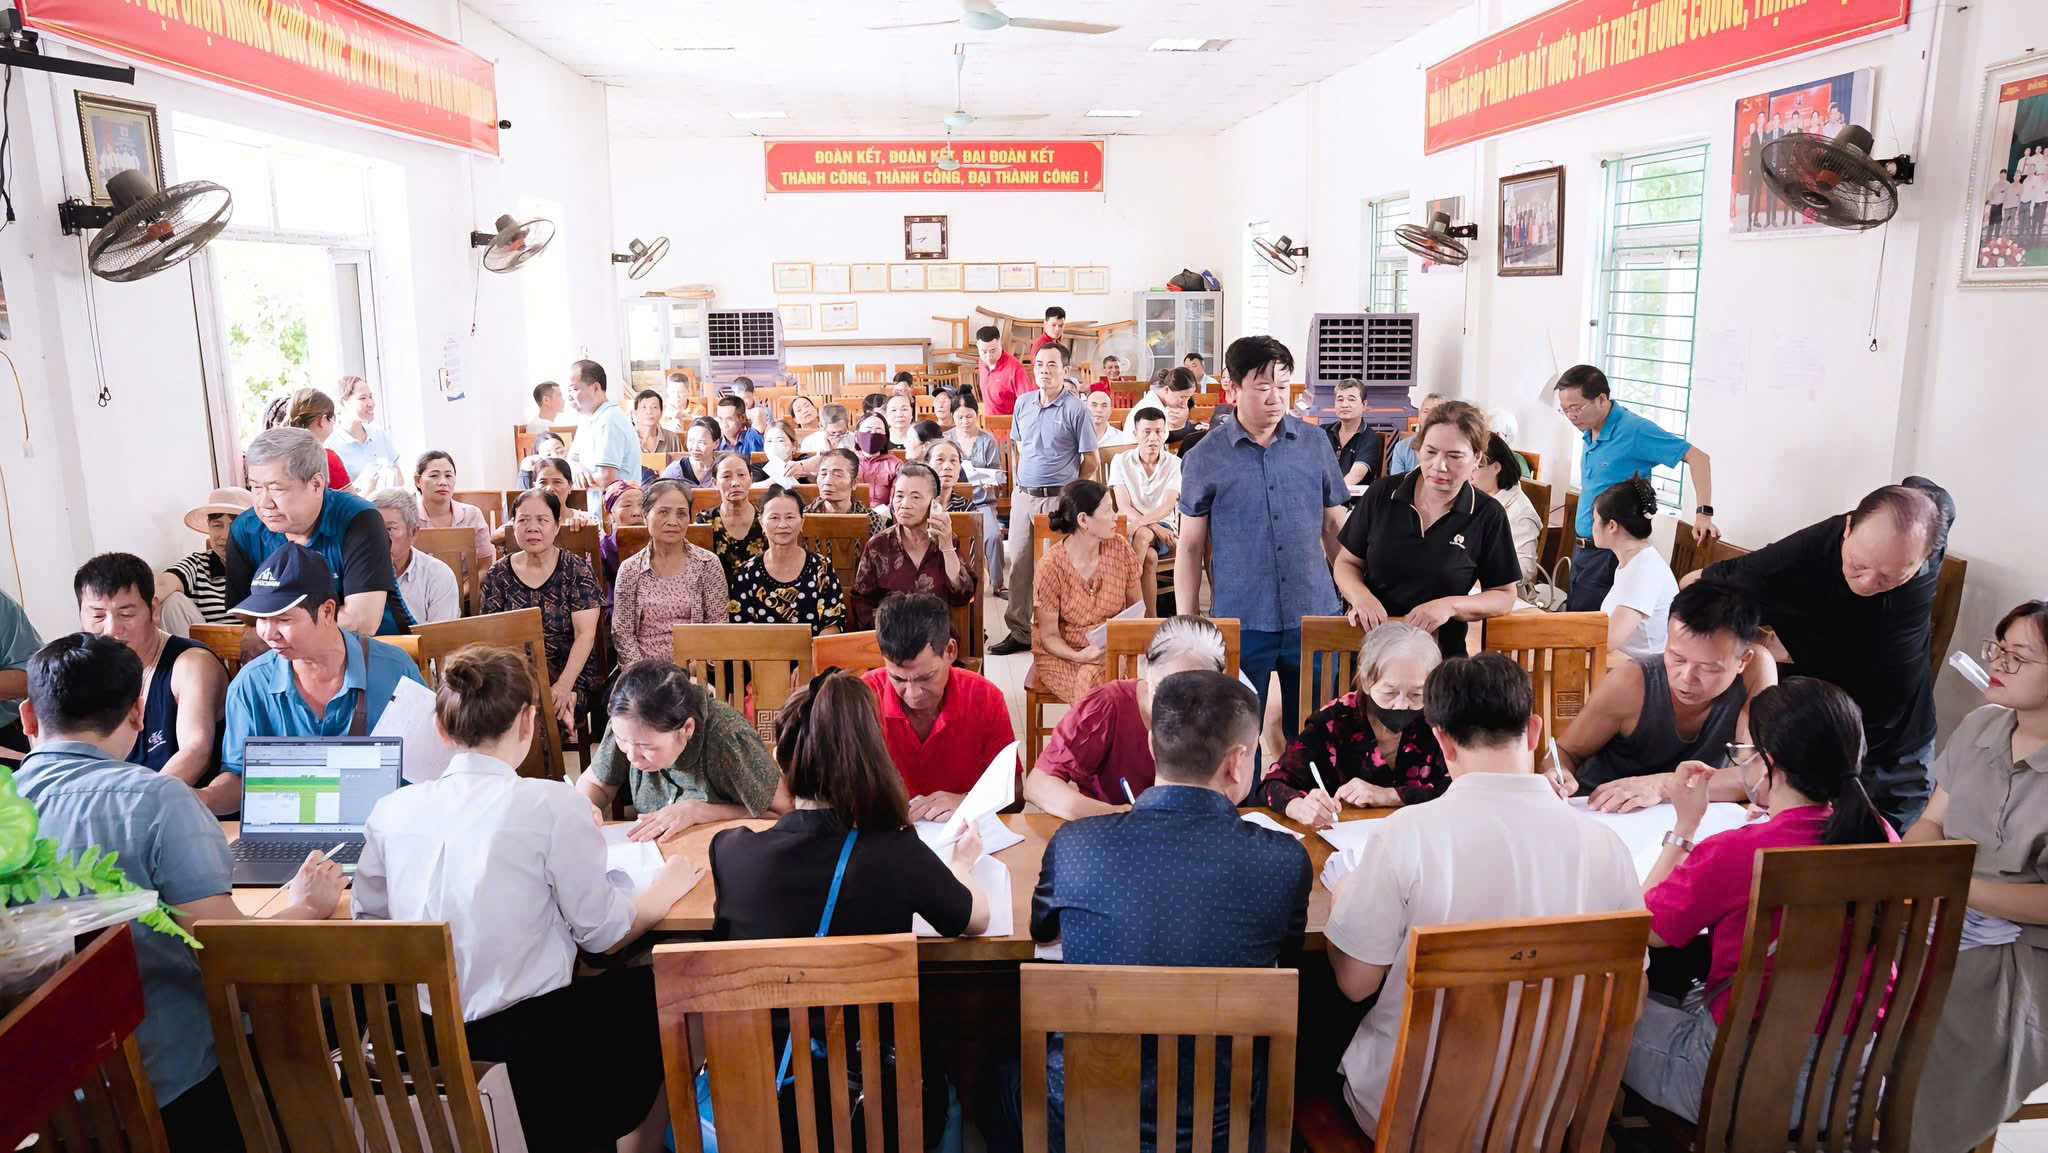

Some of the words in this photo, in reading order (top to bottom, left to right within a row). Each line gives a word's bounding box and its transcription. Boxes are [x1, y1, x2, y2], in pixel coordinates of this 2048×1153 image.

[1527, 32, 1547, 93] ĐẤT
[1547, 28, 1577, 87] NƯỚC
[1578, 15, 1609, 77] PHÁT
[815, 147, 853, 164] ĐOÀN
[856, 145, 885, 166] KẾT,
[889, 147, 926, 164] ĐOÀN
[989, 147, 1026, 163] ĐOÀN
[1030, 145, 1055, 163] KẾT
[780, 168, 826, 185] THÀNH
[829, 168, 871, 186] CÔNG,
[875, 168, 919, 185] THÀNH
[923, 168, 964, 186] CÔNG,
[967, 170, 990, 187] ĐẠI
[995, 168, 1039, 184] THÀNH
[1042, 168, 1080, 184] CÔNG
[1083, 170, 1089, 184] !
